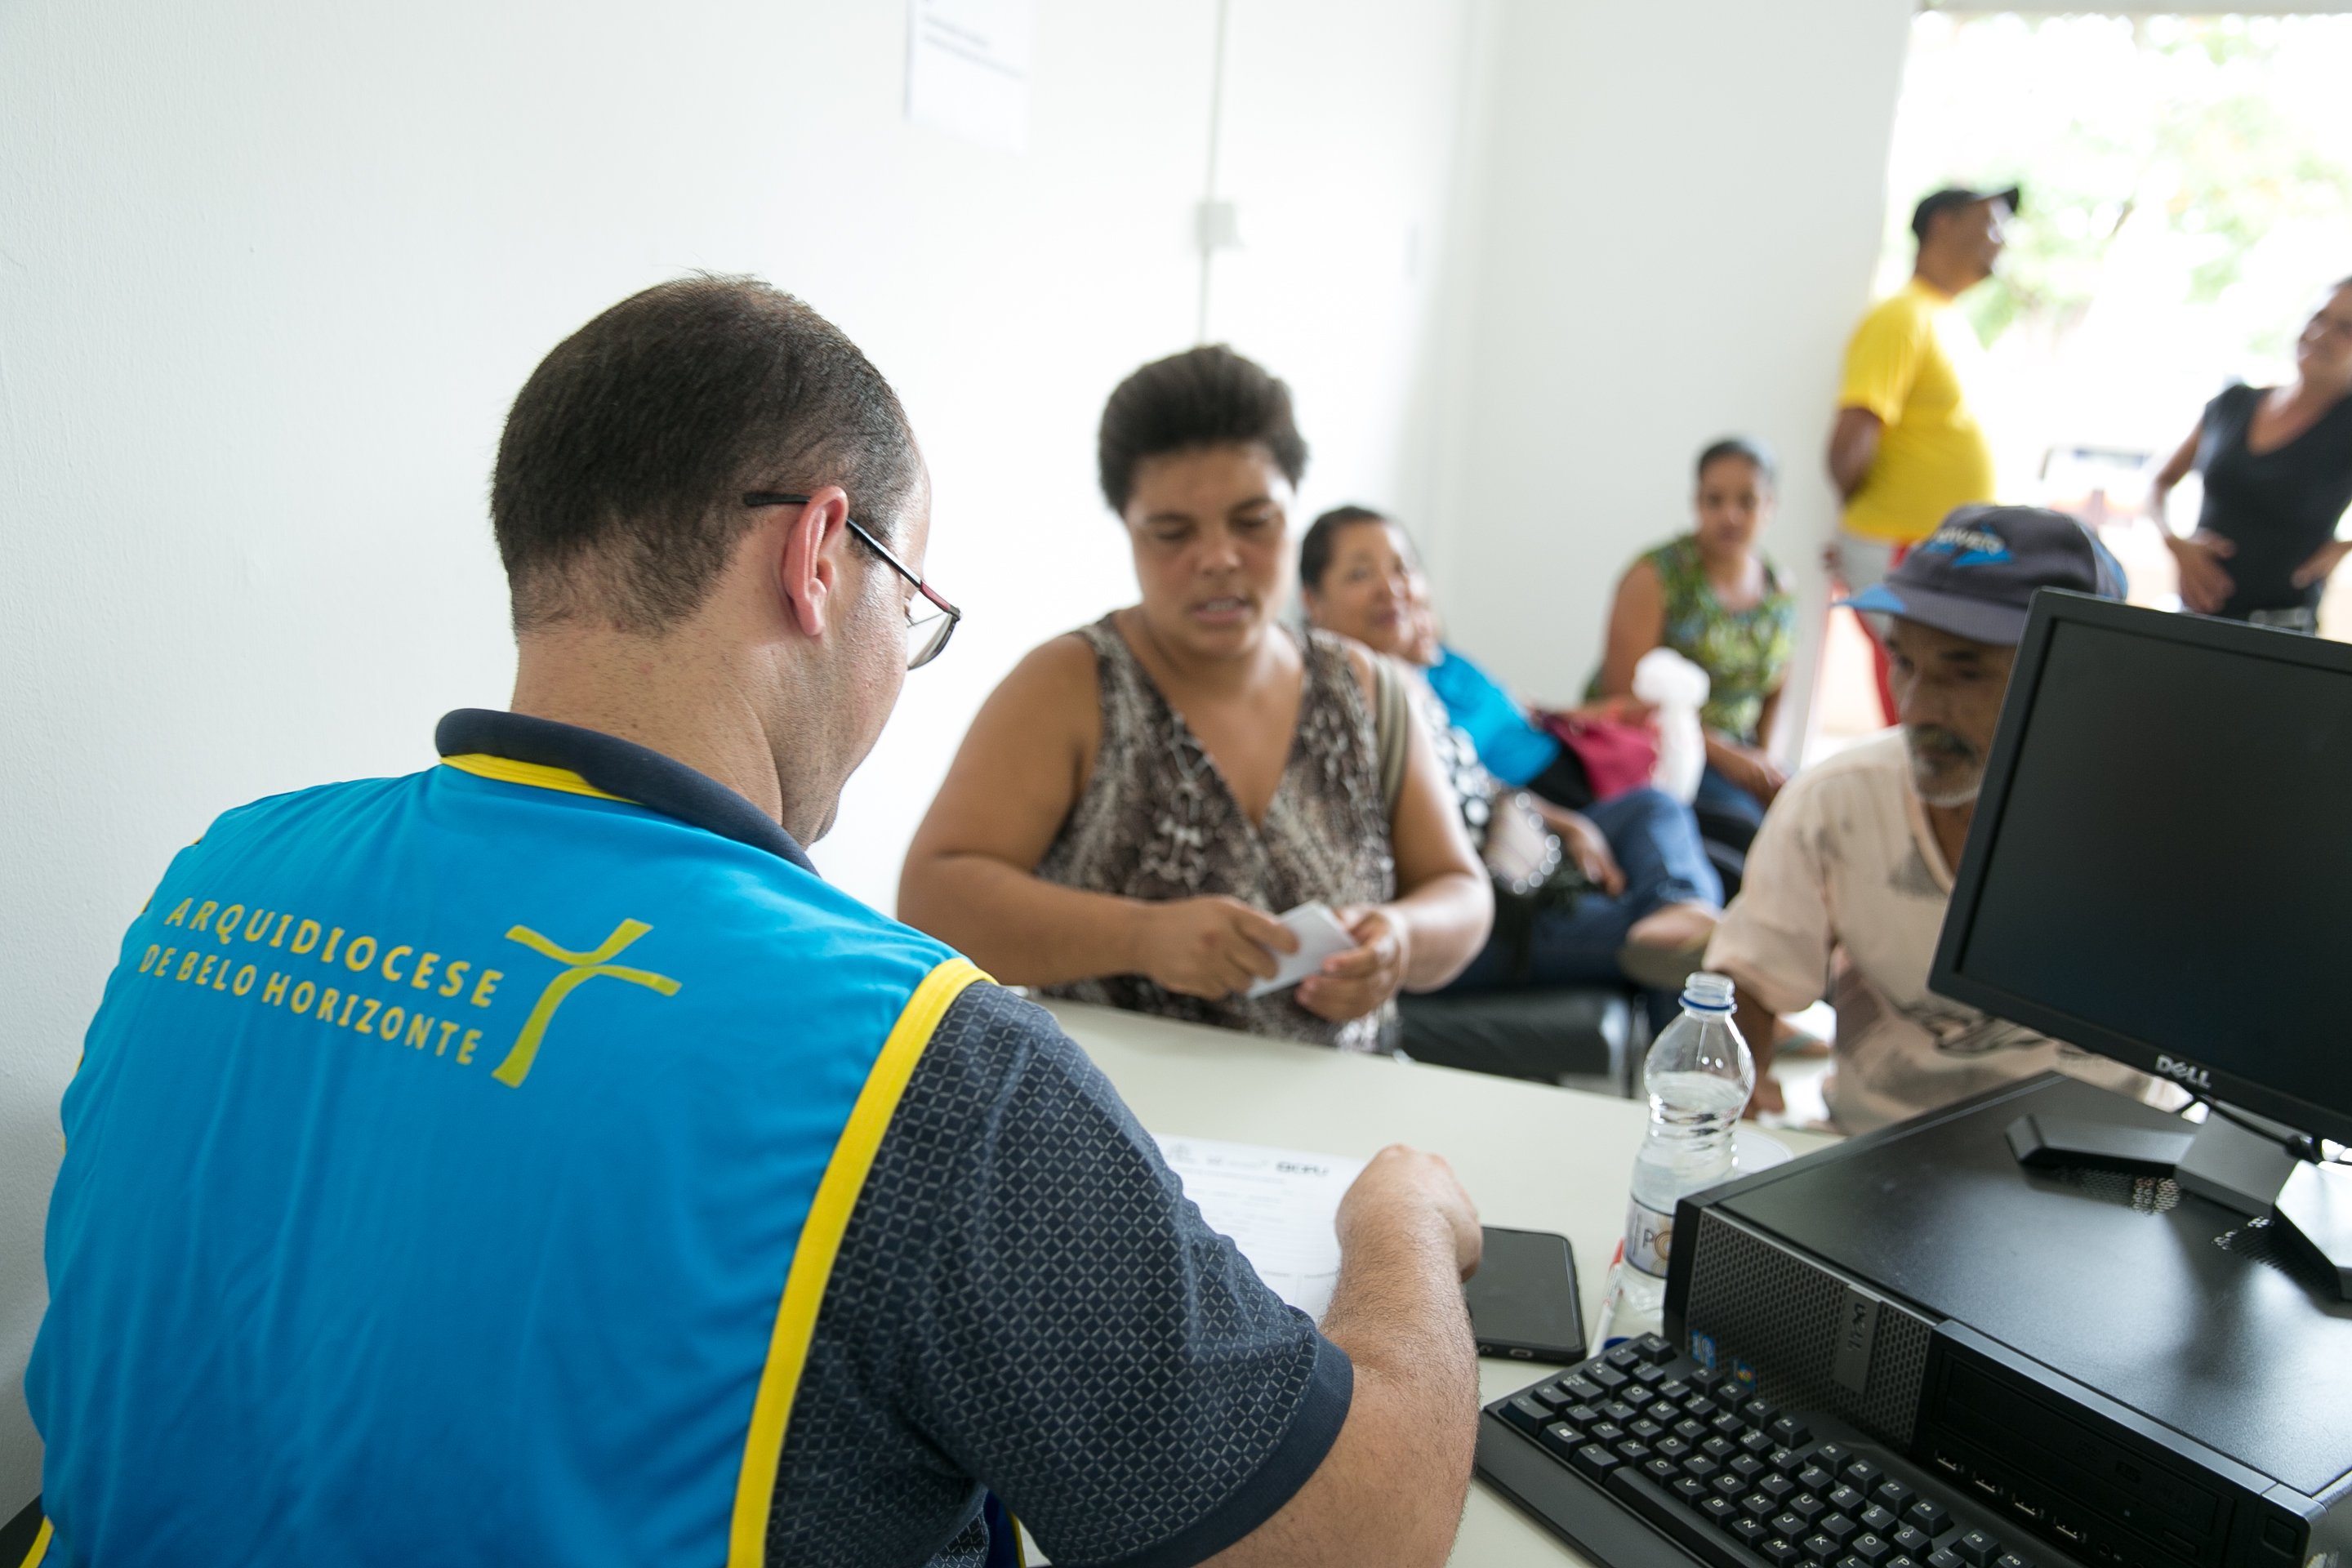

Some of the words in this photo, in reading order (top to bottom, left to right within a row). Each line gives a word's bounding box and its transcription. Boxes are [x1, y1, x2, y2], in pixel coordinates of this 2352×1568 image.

[139, 944, 176, 977] DE
[176, 951, 258, 996] BELO
[262, 971, 483, 1065] HORIZONTE
[164, 898, 504, 1009] ARQUIDIOCESE
[2155, 1054, 2212, 1090] DELL
